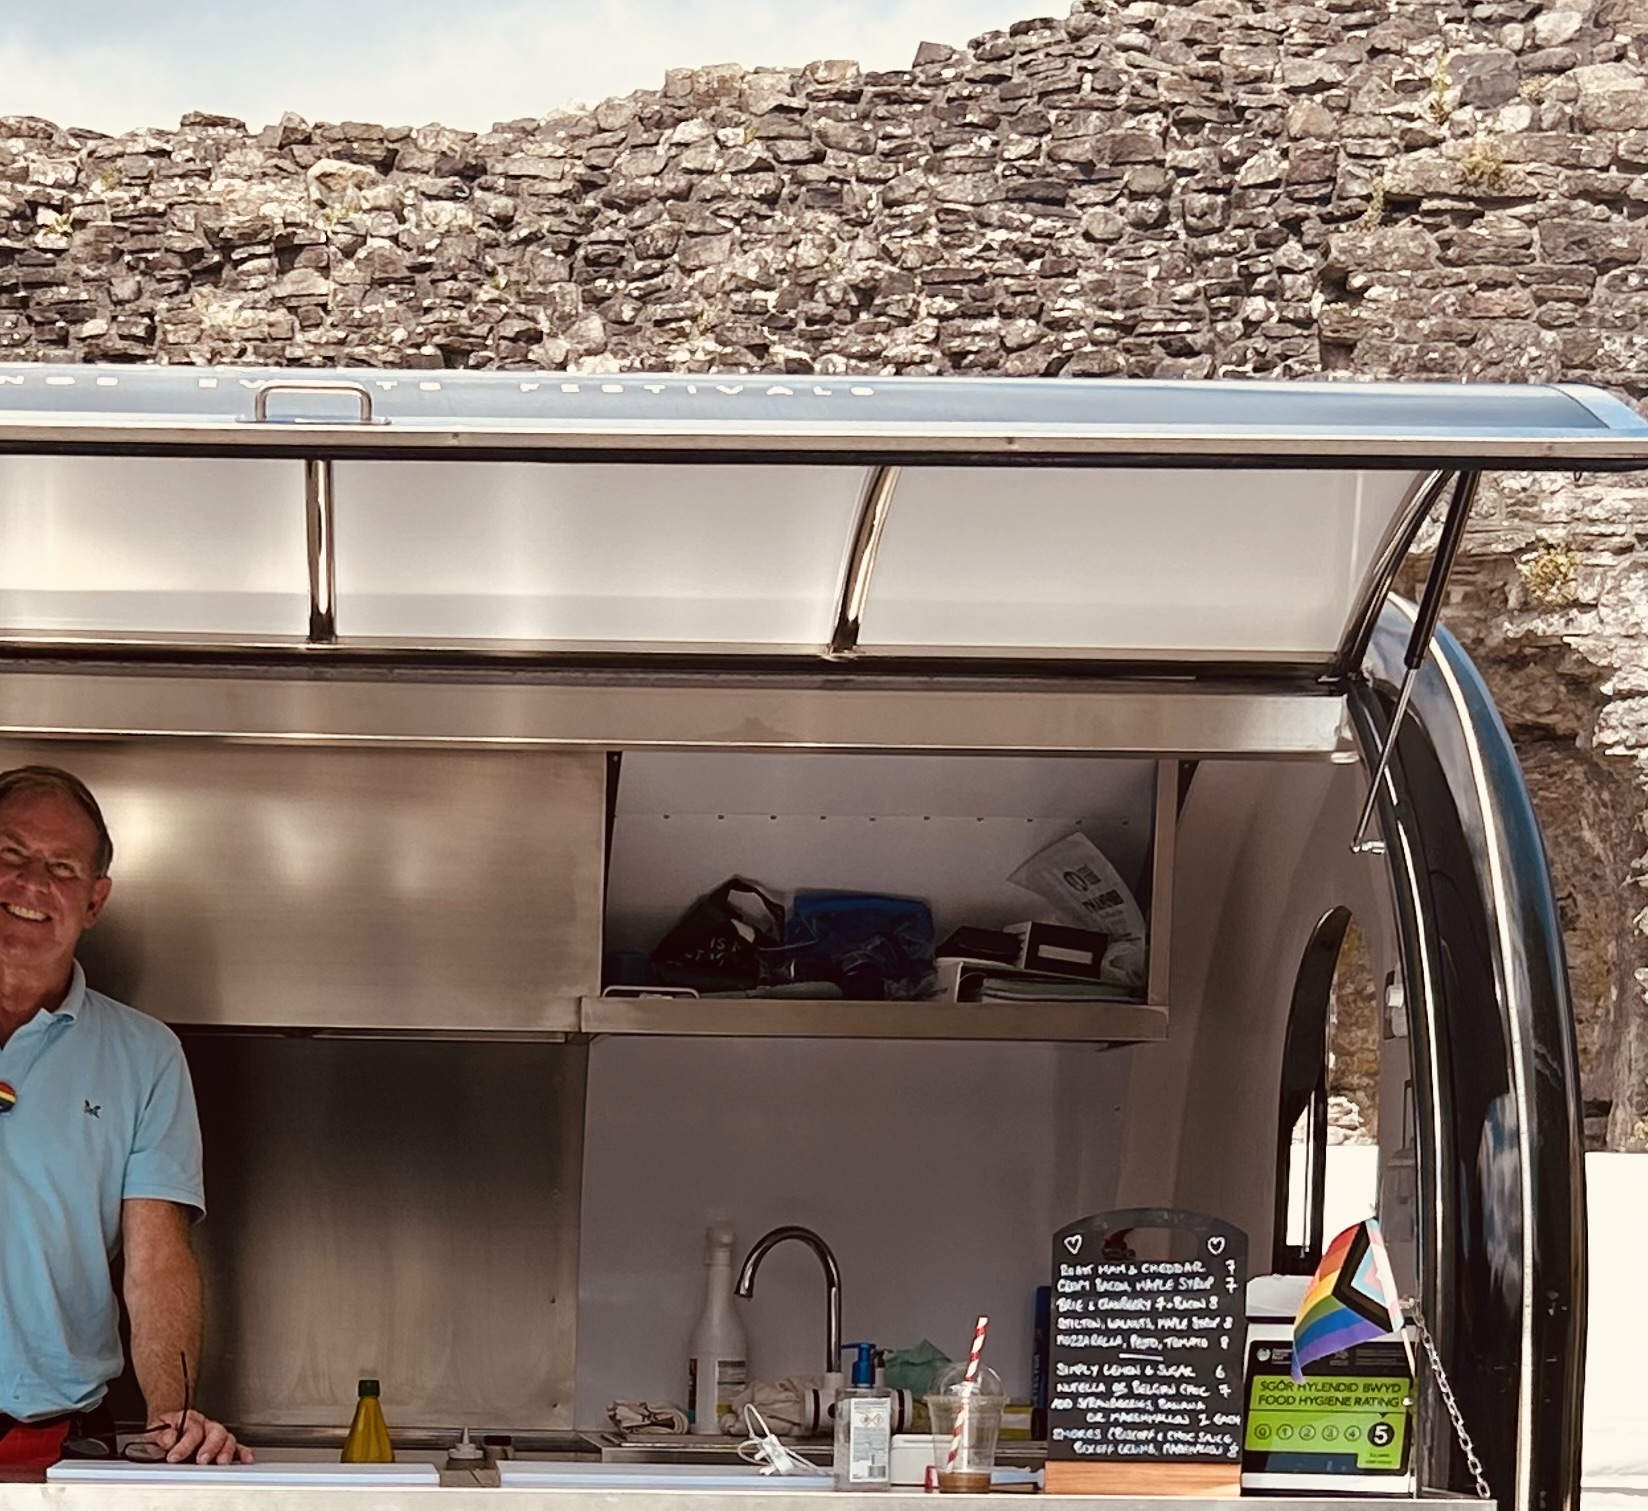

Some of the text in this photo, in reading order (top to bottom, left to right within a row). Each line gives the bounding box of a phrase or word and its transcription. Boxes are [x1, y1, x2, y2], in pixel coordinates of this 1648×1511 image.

[1098, 1264, 1126, 1275] HAM
[1141, 1261, 1206, 1274] CHEDDAR
[1225, 1259, 1235, 1275] 7
[1136, 1278, 1174, 1291] MAPLE
[1178, 1275, 1215, 1291] SYRUP
[1225, 1277, 1238, 1293] 7
[1056, 1297, 1083, 1312] BRIE
[1155, 1296, 1166, 1312] 7
[1209, 1295, 1219, 1310] 8
[1157, 1317, 1188, 1330] MAPLE
[1223, 1316, 1233, 1329] 8
[1163, 1336, 1208, 1348] TOMATO
[1056, 1362, 1099, 1377] SIMPLY
[1103, 1364, 1141, 1376] LEMON
[1215, 1364, 1226, 1379] 6
[1056, 1382, 1106, 1393] NUTELLA
[1218, 1384, 1232, 1398] 7
[1363, 1383, 1401, 1394] BWYD
[1158, 1398, 1206, 1410] BANANA
[1258, 1395, 1399, 1407] FOOD HYGIENE RATING
[1086, 1412, 1106, 1423] OR
[1167, 1431, 1196, 1441] CHOC
[1373, 1426, 1389, 1445] 5
